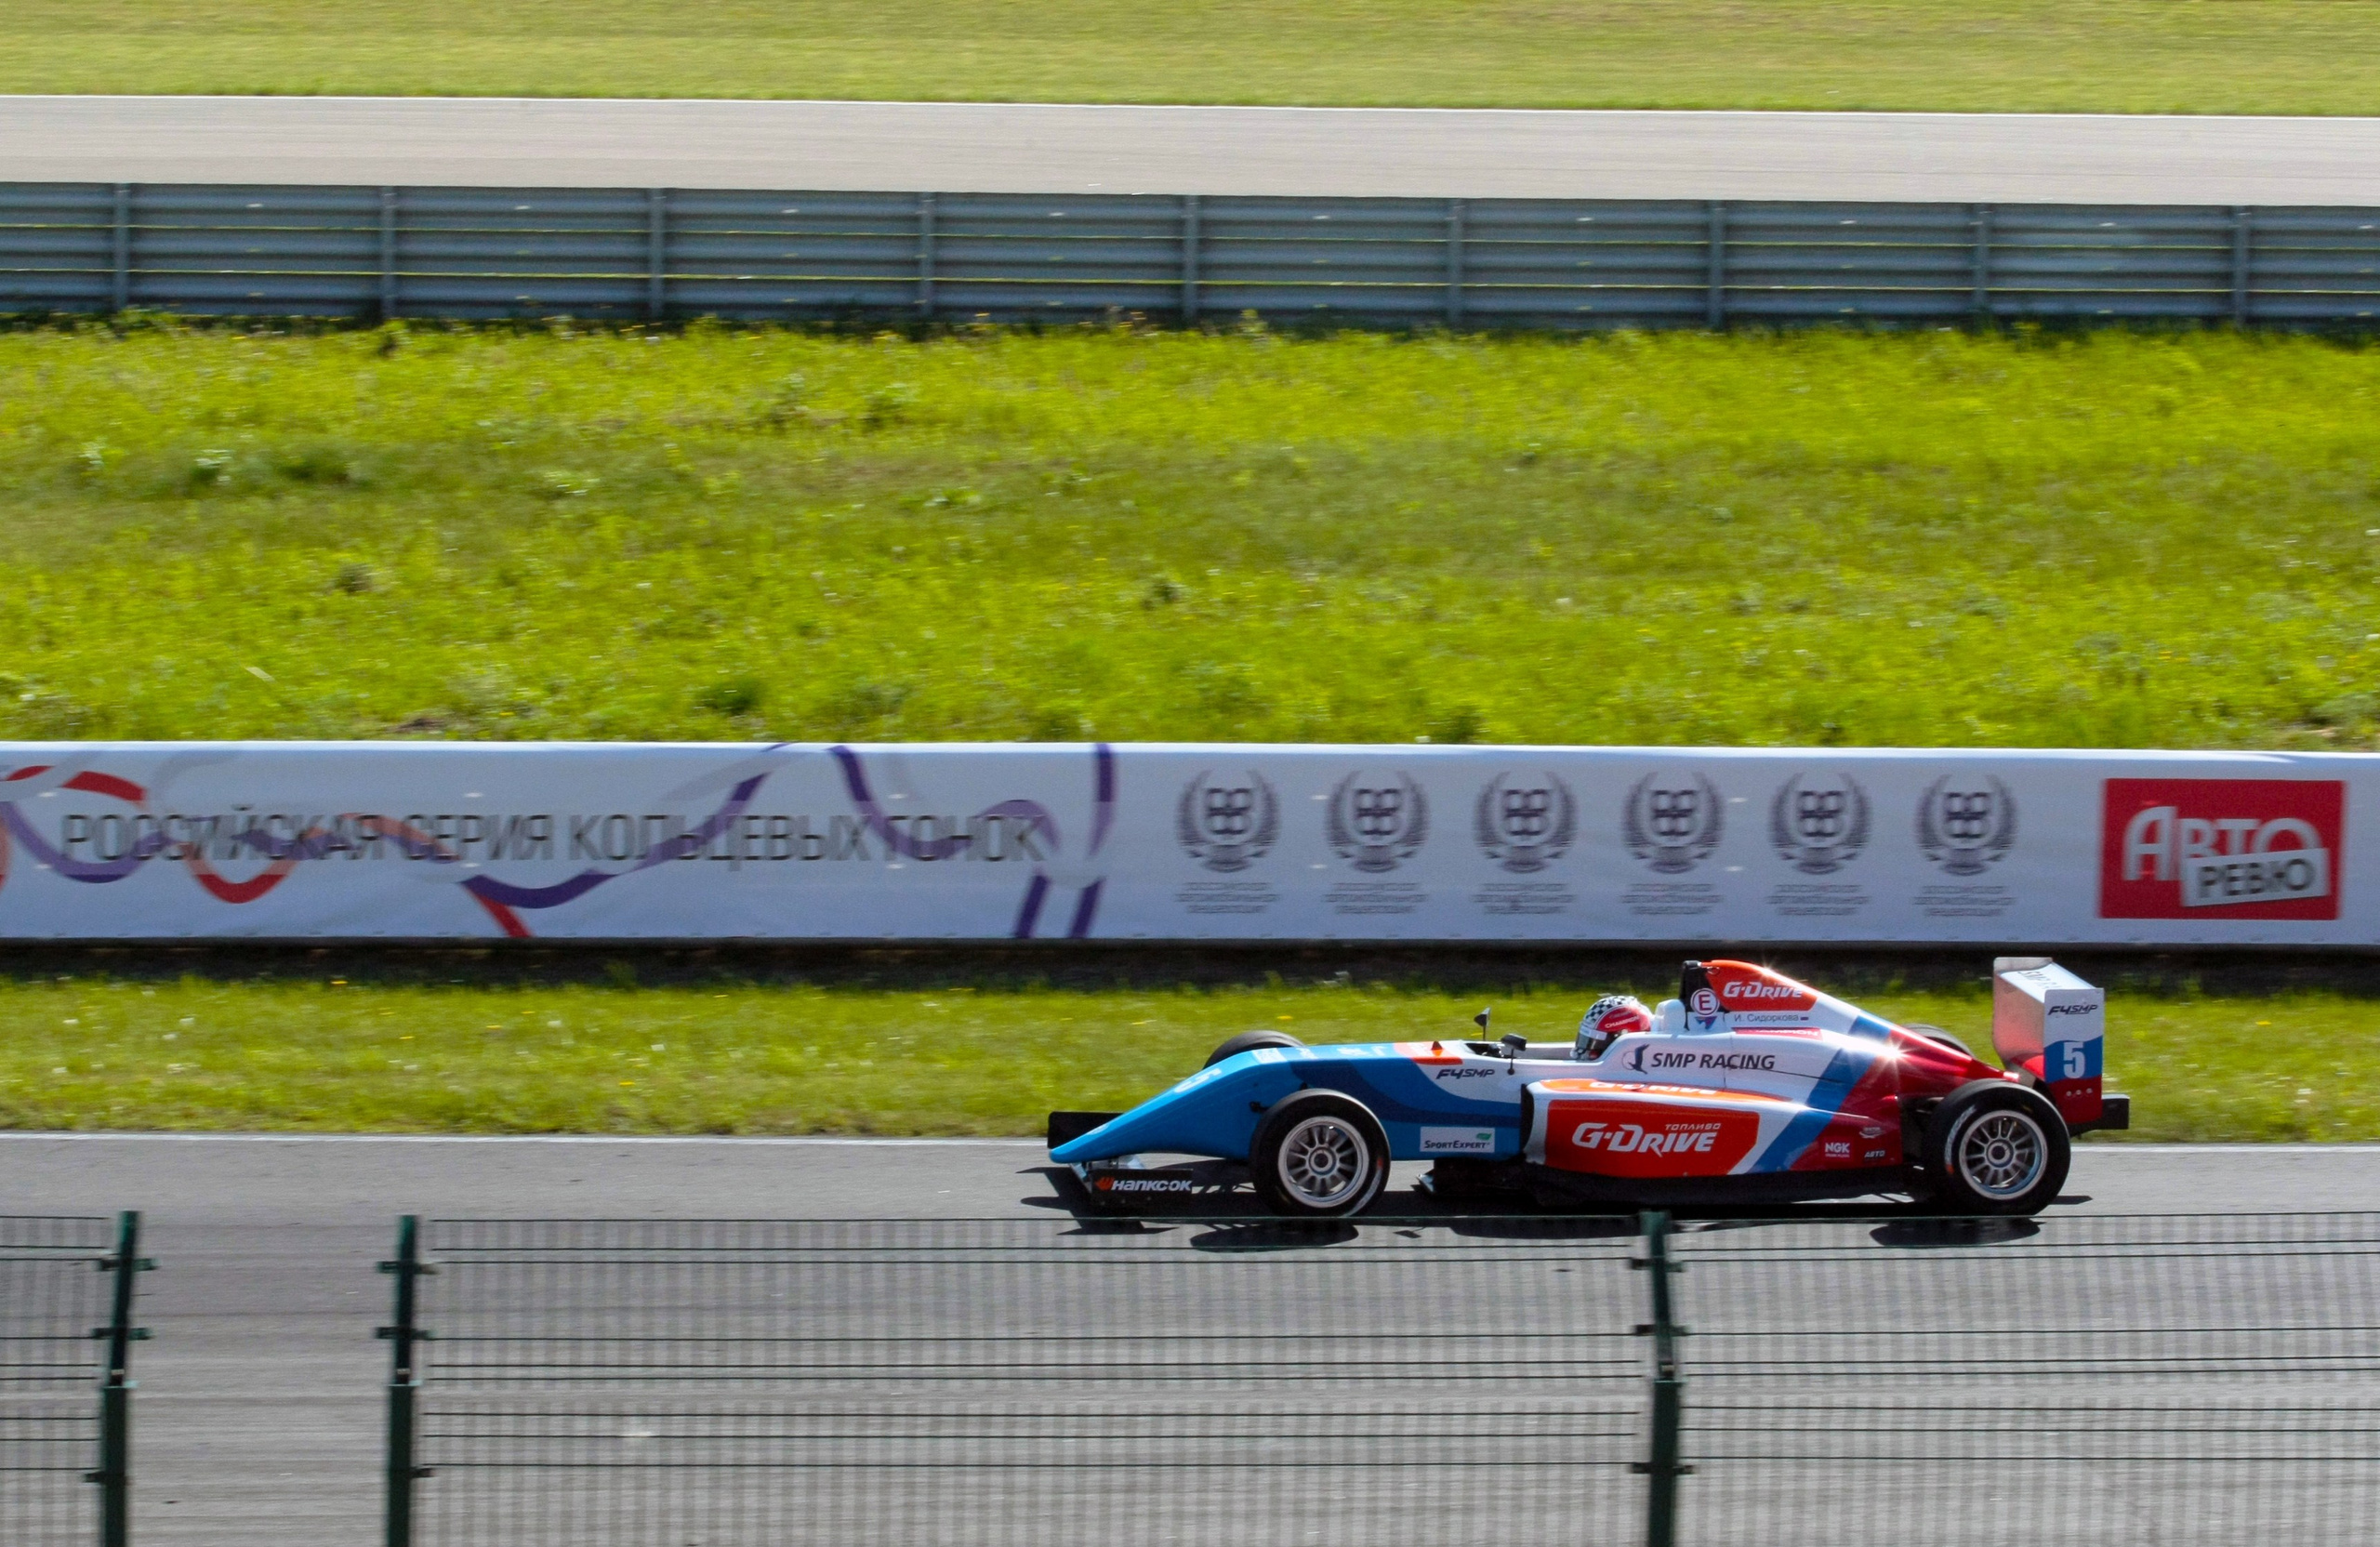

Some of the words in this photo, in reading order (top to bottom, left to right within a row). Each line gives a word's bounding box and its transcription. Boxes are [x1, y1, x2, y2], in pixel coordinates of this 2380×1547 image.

[60, 803, 384, 863] РОССИЙСКАЯ
[402, 812, 554, 862] СЕРИЯ
[567, 813, 872, 872] КОЛЬЦЕВЫХ
[885, 813, 1049, 863] ГОНОК
[2122, 805, 2324, 881] АВТО
[2196, 856, 2317, 900] РЕВЮ
[1698, 994, 1712, 1012] E
[1651, 1052, 1696, 1068] SMP
[1699, 1053, 1775, 1070] RACING
[2064, 1041, 2085, 1078] 5
[1825, 1143, 1850, 1153] NGK
